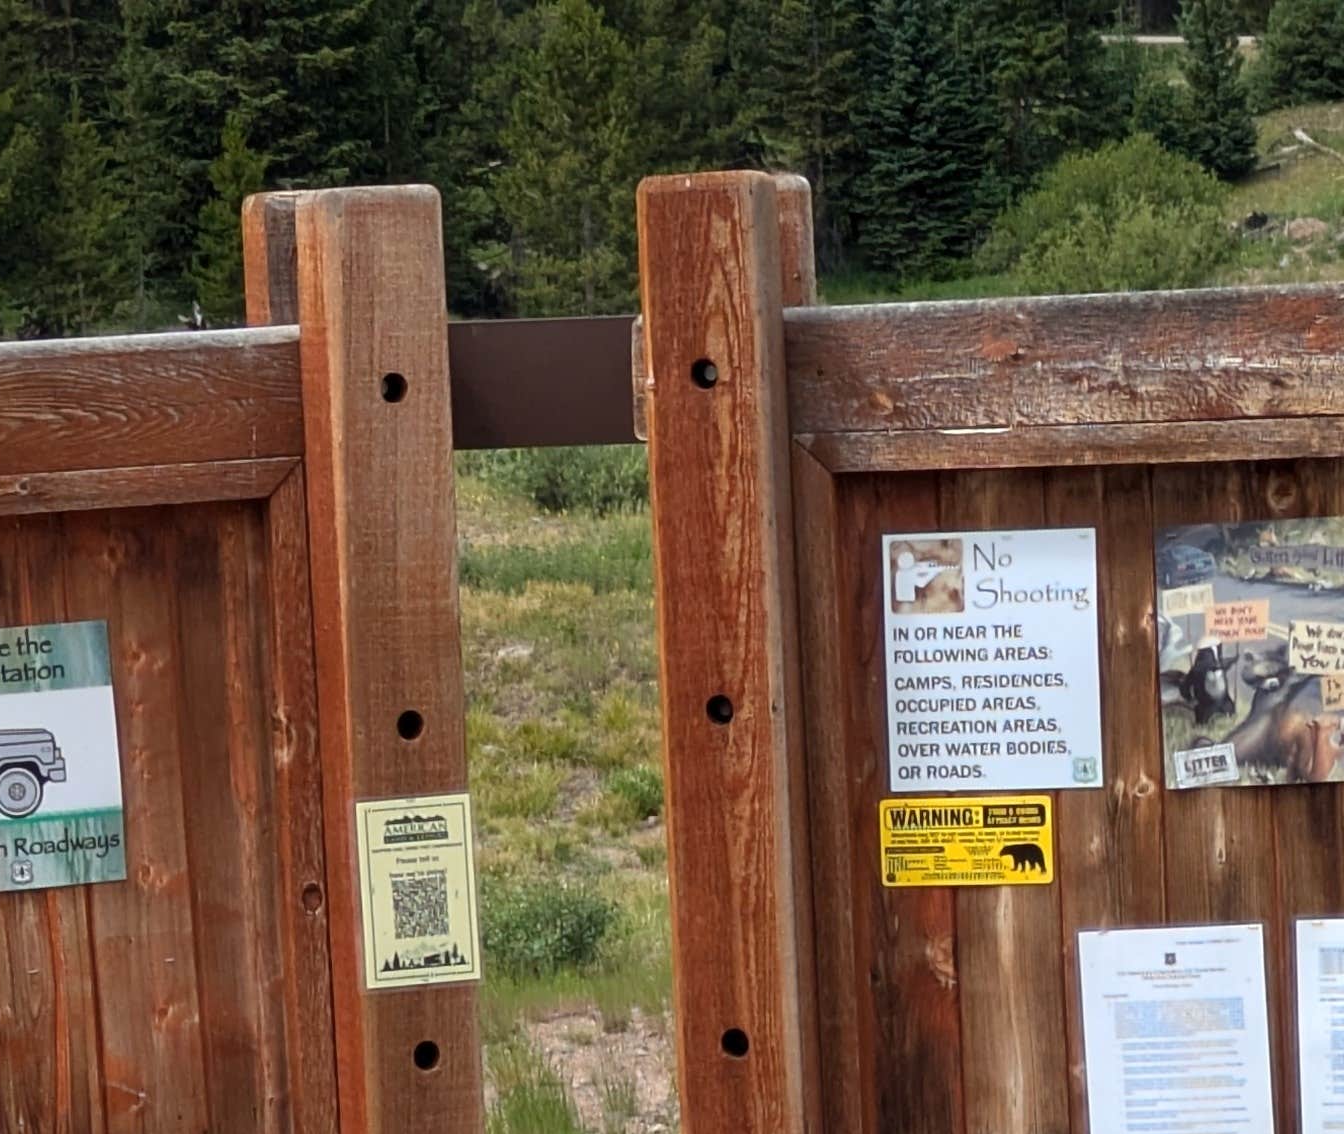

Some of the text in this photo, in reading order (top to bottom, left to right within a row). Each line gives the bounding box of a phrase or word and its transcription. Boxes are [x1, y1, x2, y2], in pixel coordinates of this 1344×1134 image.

[973, 542, 1012, 571] No
[972, 578, 1090, 611] Shooting
[16, 628, 53, 655] the
[893, 624, 1023, 642] IN OR NEAR THE
[894, 649, 988, 664] FOLLOWING
[894, 673, 1068, 692] CAMPS, RESIDENCES,
[895, 696, 1041, 713] OCCUPIED AREAS,
[896, 718, 1062, 735] RECREATION AREAS,
[897, 740, 1072, 758] OVER WATER BODIES,
[898, 764, 987, 780] OR ROADS.
[1184, 754, 1227, 773] LITTER
[889, 808, 980, 828] WARNING:
[14, 827, 121, 859] Roadways
